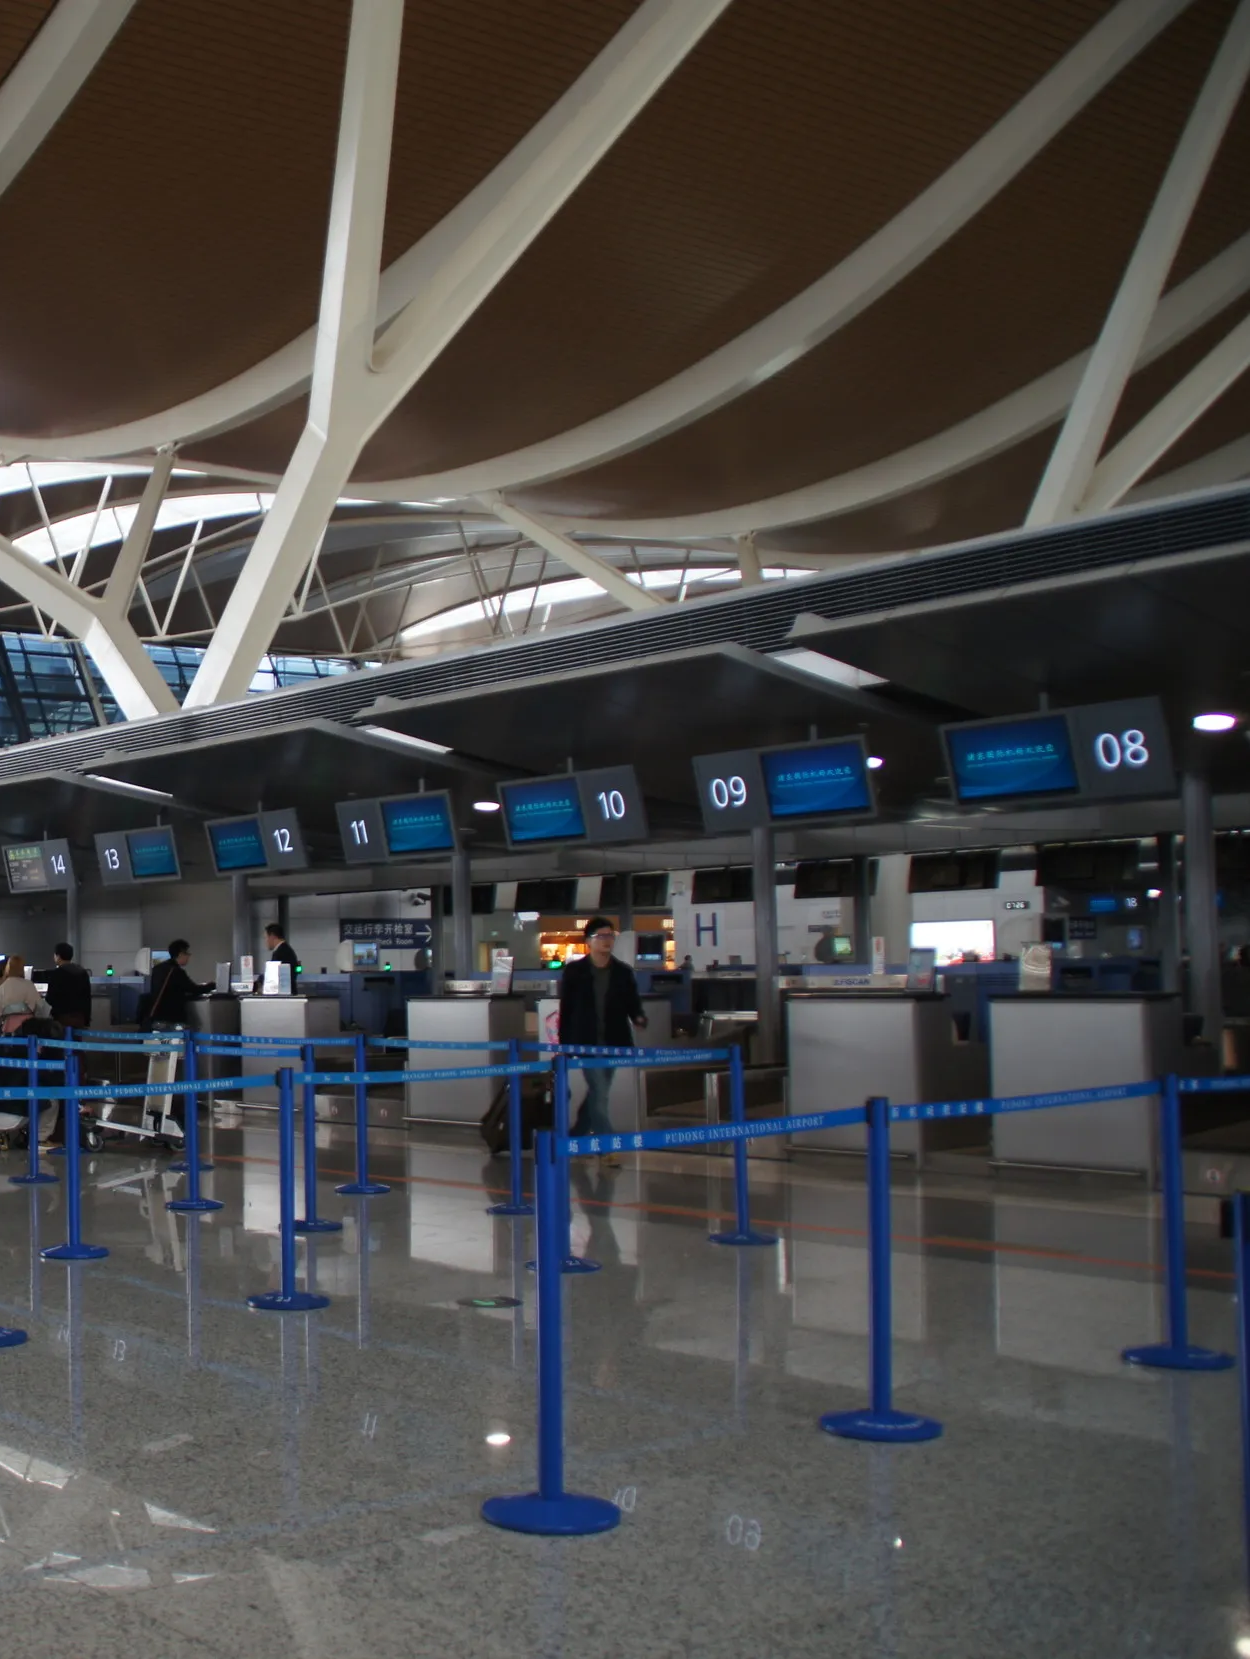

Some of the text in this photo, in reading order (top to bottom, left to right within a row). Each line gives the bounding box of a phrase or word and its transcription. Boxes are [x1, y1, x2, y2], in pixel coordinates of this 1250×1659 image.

[1095, 728, 1149, 769] 08
[712, 775, 747, 808] 09
[598, 790, 625, 820] 10
[273, 828, 293, 853] 12
[350, 819, 368, 845] 11
[50, 854, 66, 874] 14
[104, 848, 120, 870] 13
[1126, 897, 1138, 907] 18
[344, 923, 414, 936] 交运行李开检室
[695, 912, 718, 947] H
[74, 1080, 234, 1097] SHANGHAI PUDONG INTERNATIONAL AIRPORT
[1034, 1091, 1096, 1108] INTERNATIONAL
[1097, 1087, 1128, 1099] AIRPORT
[664, 1115, 825, 1144] PUDONG INTERNATIONAL AIRPORT
